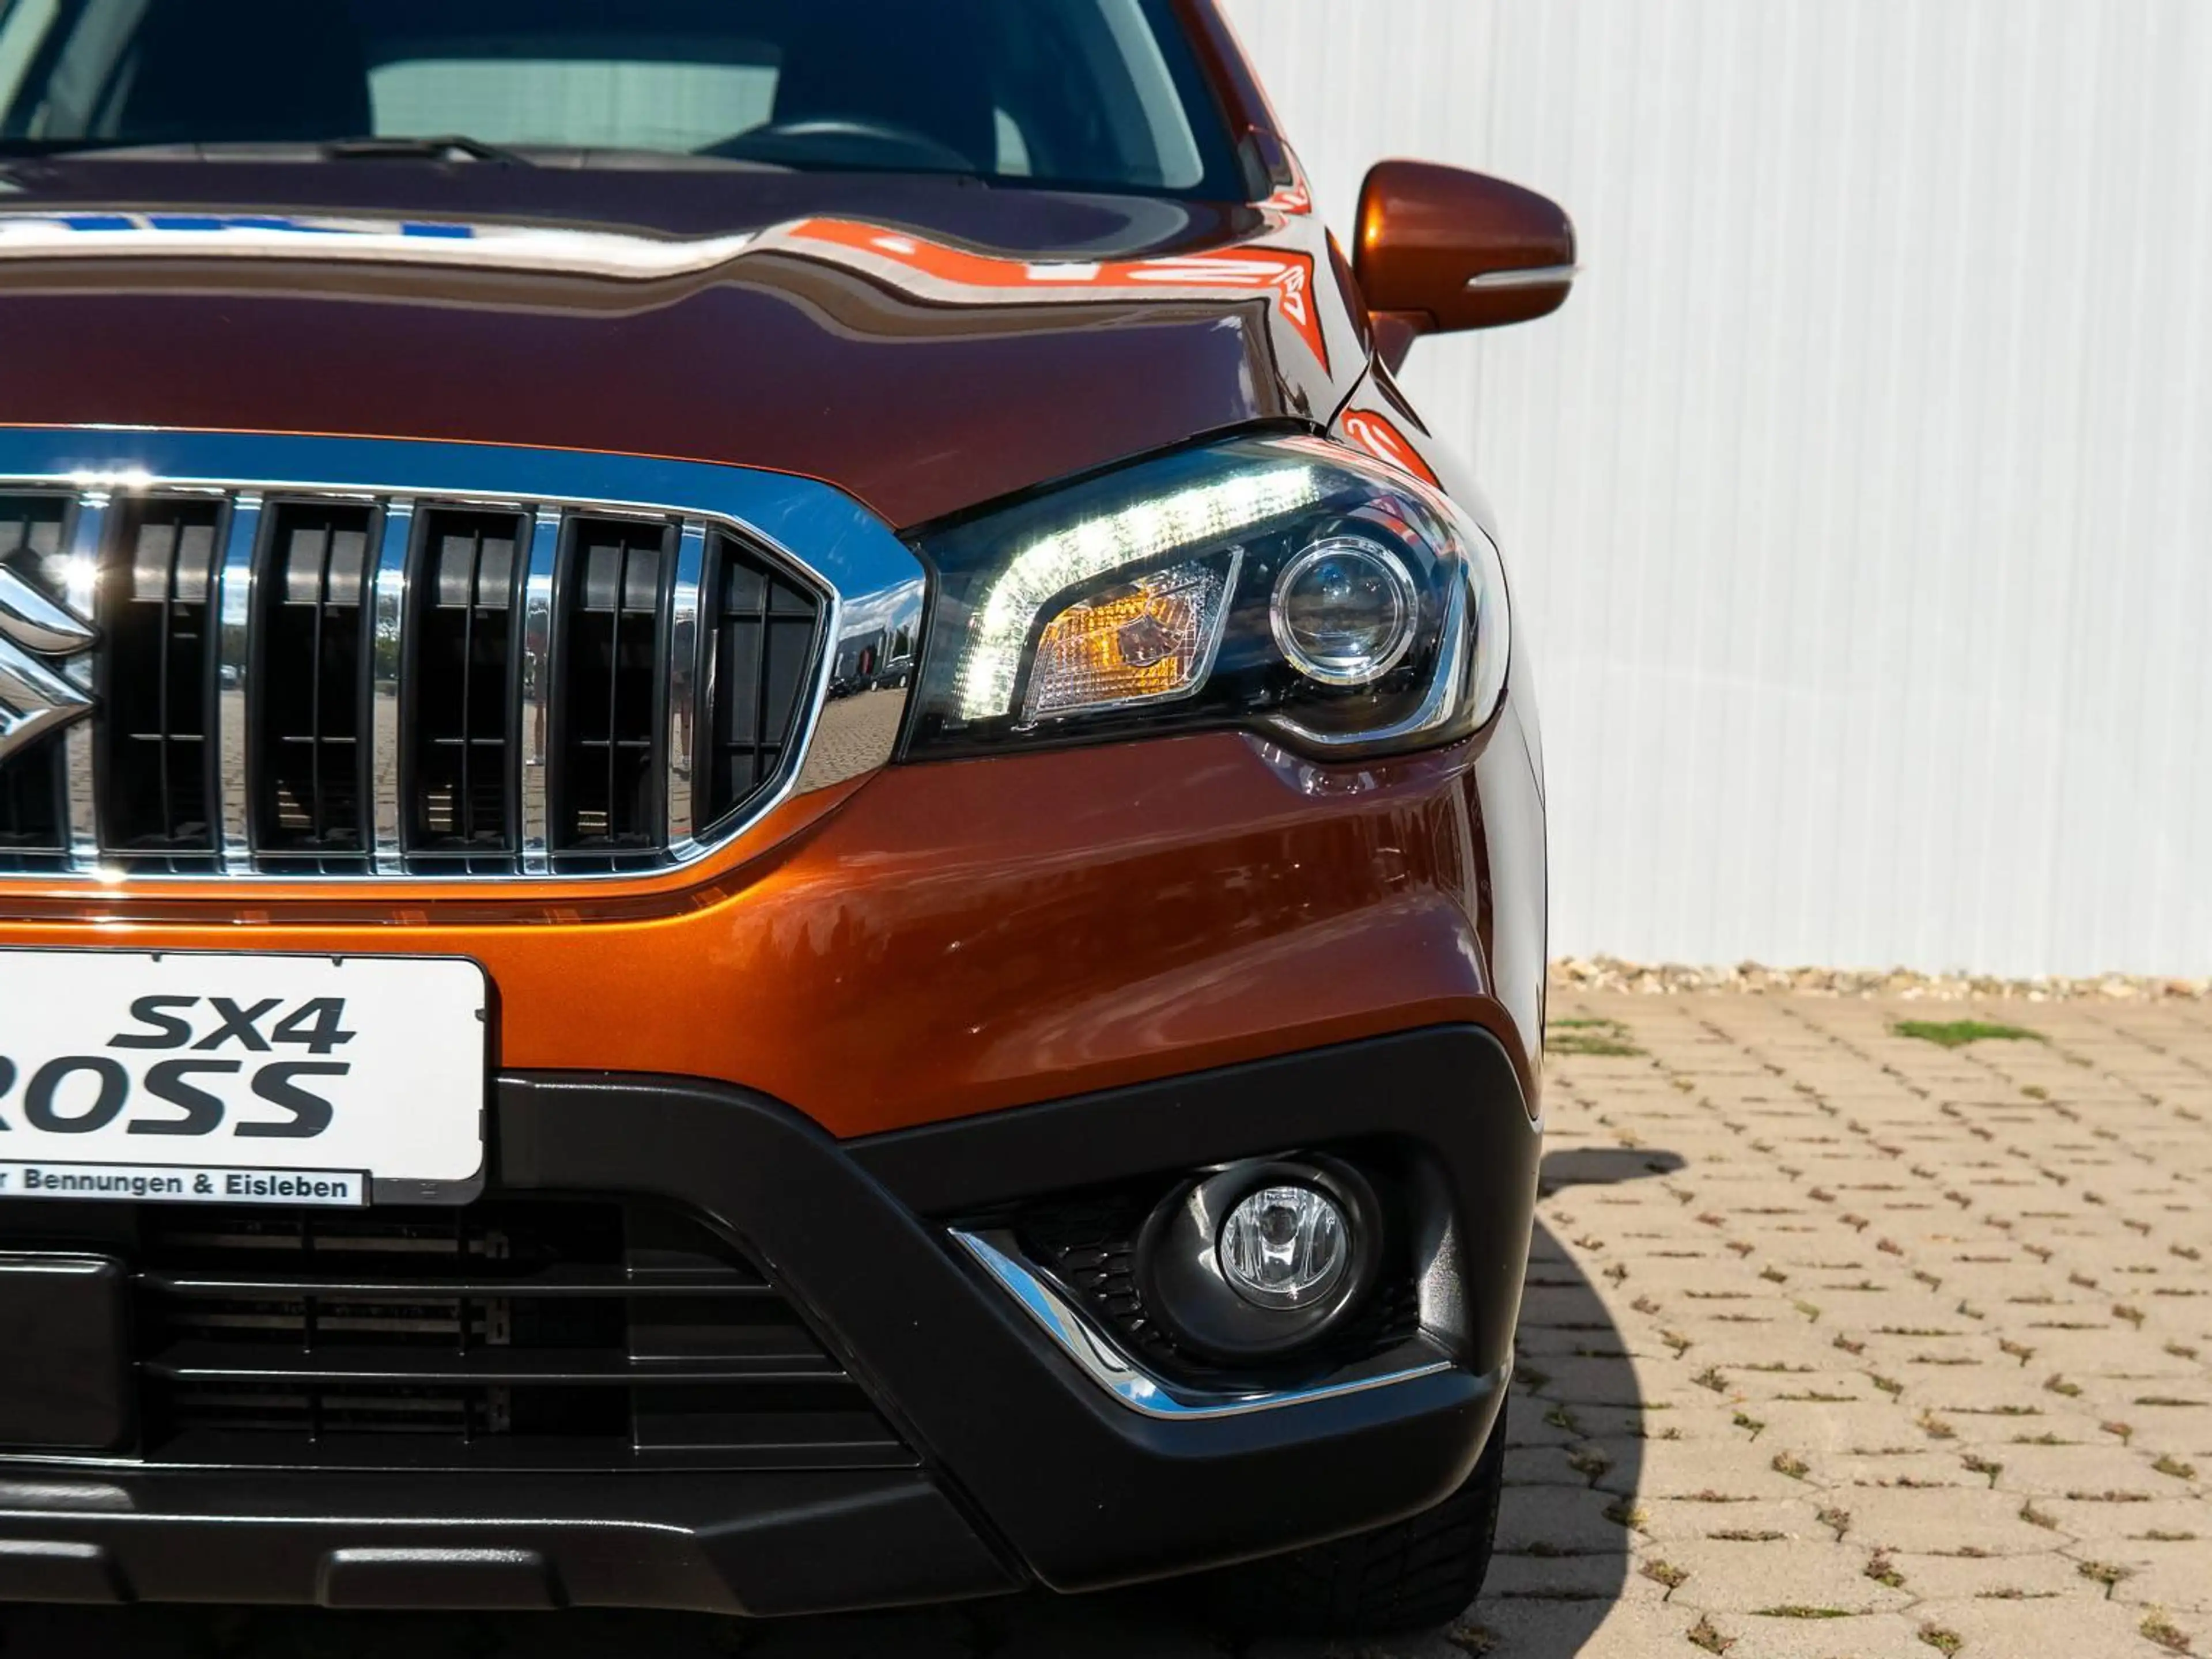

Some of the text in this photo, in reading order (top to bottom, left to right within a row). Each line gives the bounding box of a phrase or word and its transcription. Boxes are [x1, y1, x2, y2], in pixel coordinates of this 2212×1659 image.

[106, 995, 357, 1054] SX4
[0, 1055, 350, 1138] OSS
[24, 1168, 182, 1197] Bennungen
[193, 1173, 213, 1194] &
[226, 1174, 347, 1198] Eisleben
